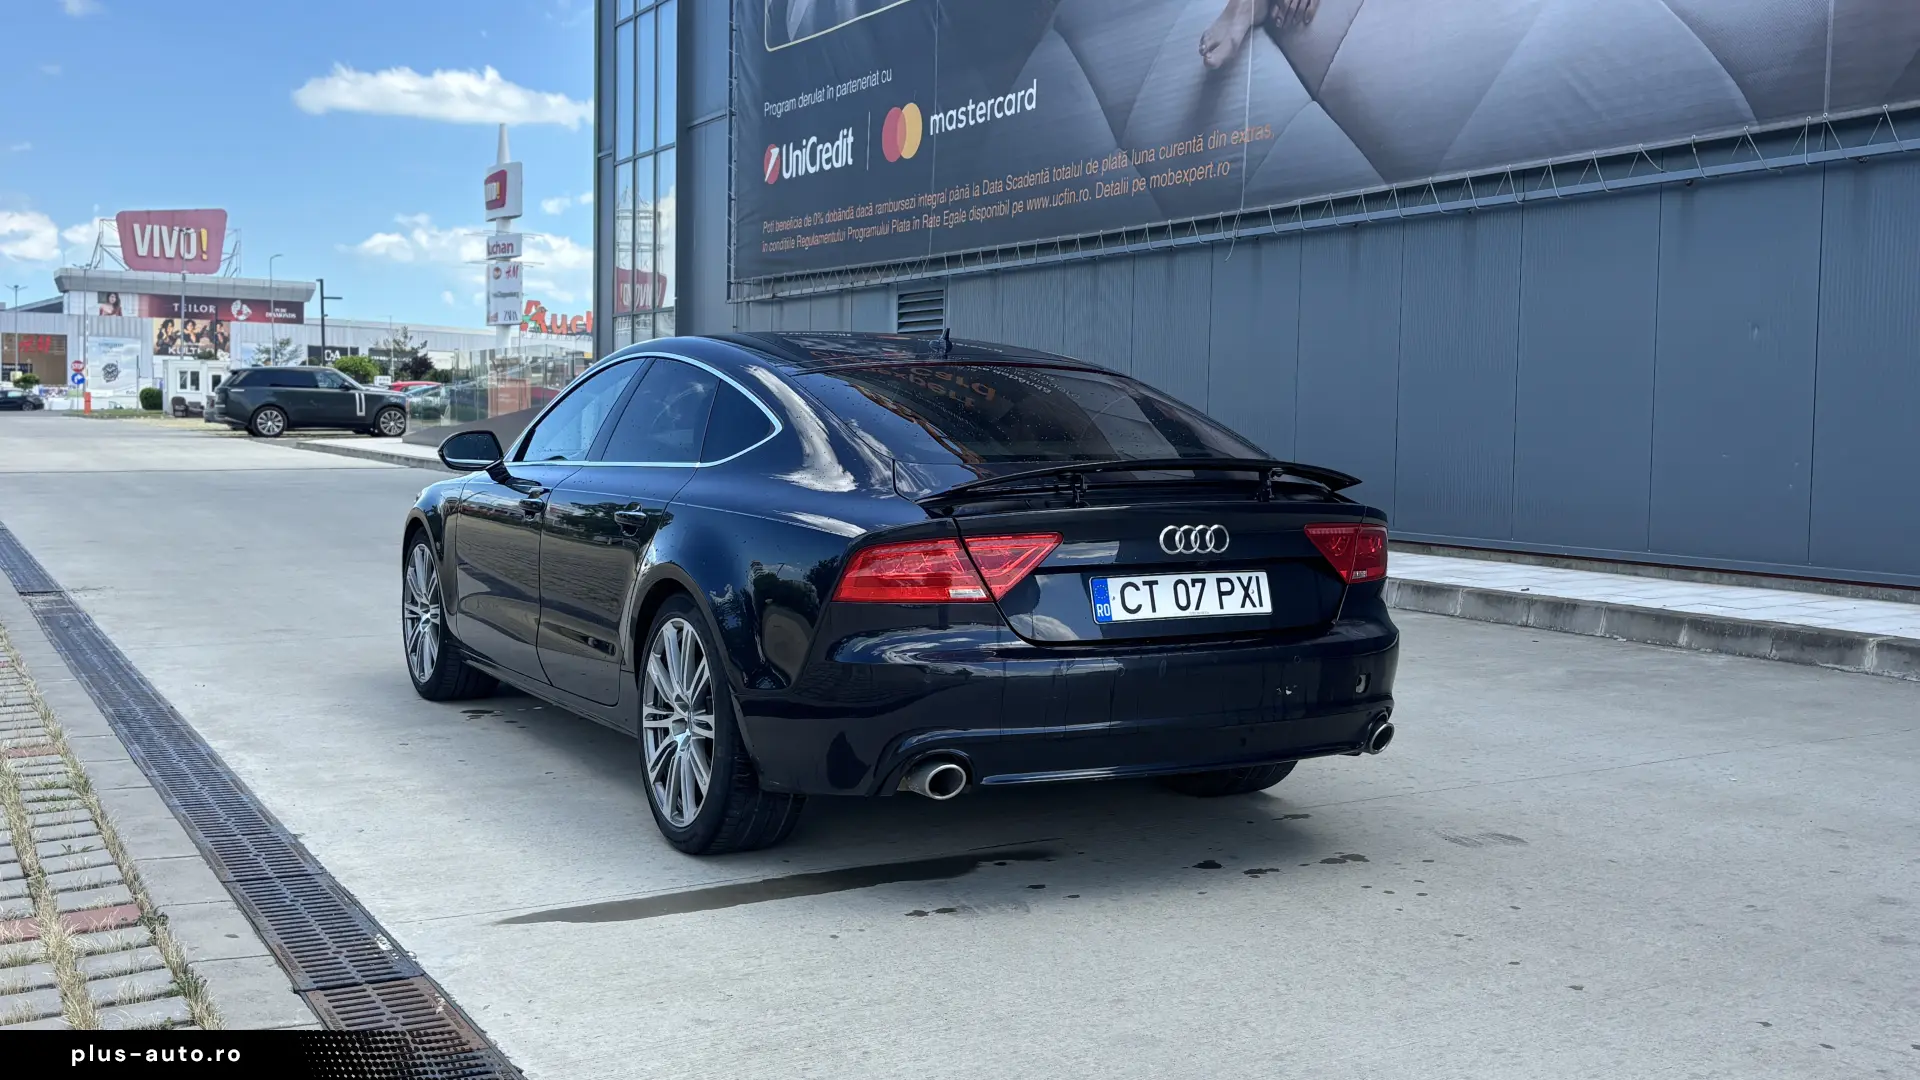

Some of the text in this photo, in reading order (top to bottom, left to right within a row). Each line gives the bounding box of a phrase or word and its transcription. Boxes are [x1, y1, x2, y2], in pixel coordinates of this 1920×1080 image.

[764, 98, 797, 118] Program
[798, 87, 825, 109] derulat
[836, 69, 880, 101] parteneriat
[881, 68, 893, 84] cu
[930, 78, 1037, 136] mastercard
[782, 126, 854, 179] UniCredit
[776, 215, 803, 233] beneficia
[804, 214, 813, 228] de
[813, 211, 825, 226] 0%
[856, 202, 873, 218] dacă
[875, 193, 917, 215] rambursezi
[918, 187, 948, 209] integral
[949, 183, 970, 205] până
[973, 181, 980, 198] la
[982, 178, 1004, 196] Data
[1005, 167, 1050, 191] Scadentă
[1052, 159, 1083, 183] totalul
[1085, 157, 1099, 176] de
[1101, 149, 1128, 177] plată
[1131, 147, 1155, 167] luna
[1158, 132, 1204, 160] curentă
[1208, 128, 1227, 151] din
[796, 227, 846, 250] Regulamentului
[847, 219, 890, 243] Programului
[891, 216, 911, 233] Plata
[922, 213, 941, 229] Rate
[943, 207, 967, 229] Egale
[969, 199, 1010, 223] disponibil
[1011, 199, 1024, 218] pe
[1095, 178, 1129, 200] Detalii
[1131, 177, 1147, 197] pe
[1149, 159, 1231, 188] mobexpert.ro
[132, 222, 209, 261] VIVO!
[487, 240, 514, 256] uchan
[1096, 603, 1112, 617] RO
[1119, 575, 1265, 615] CT 07 PXI
